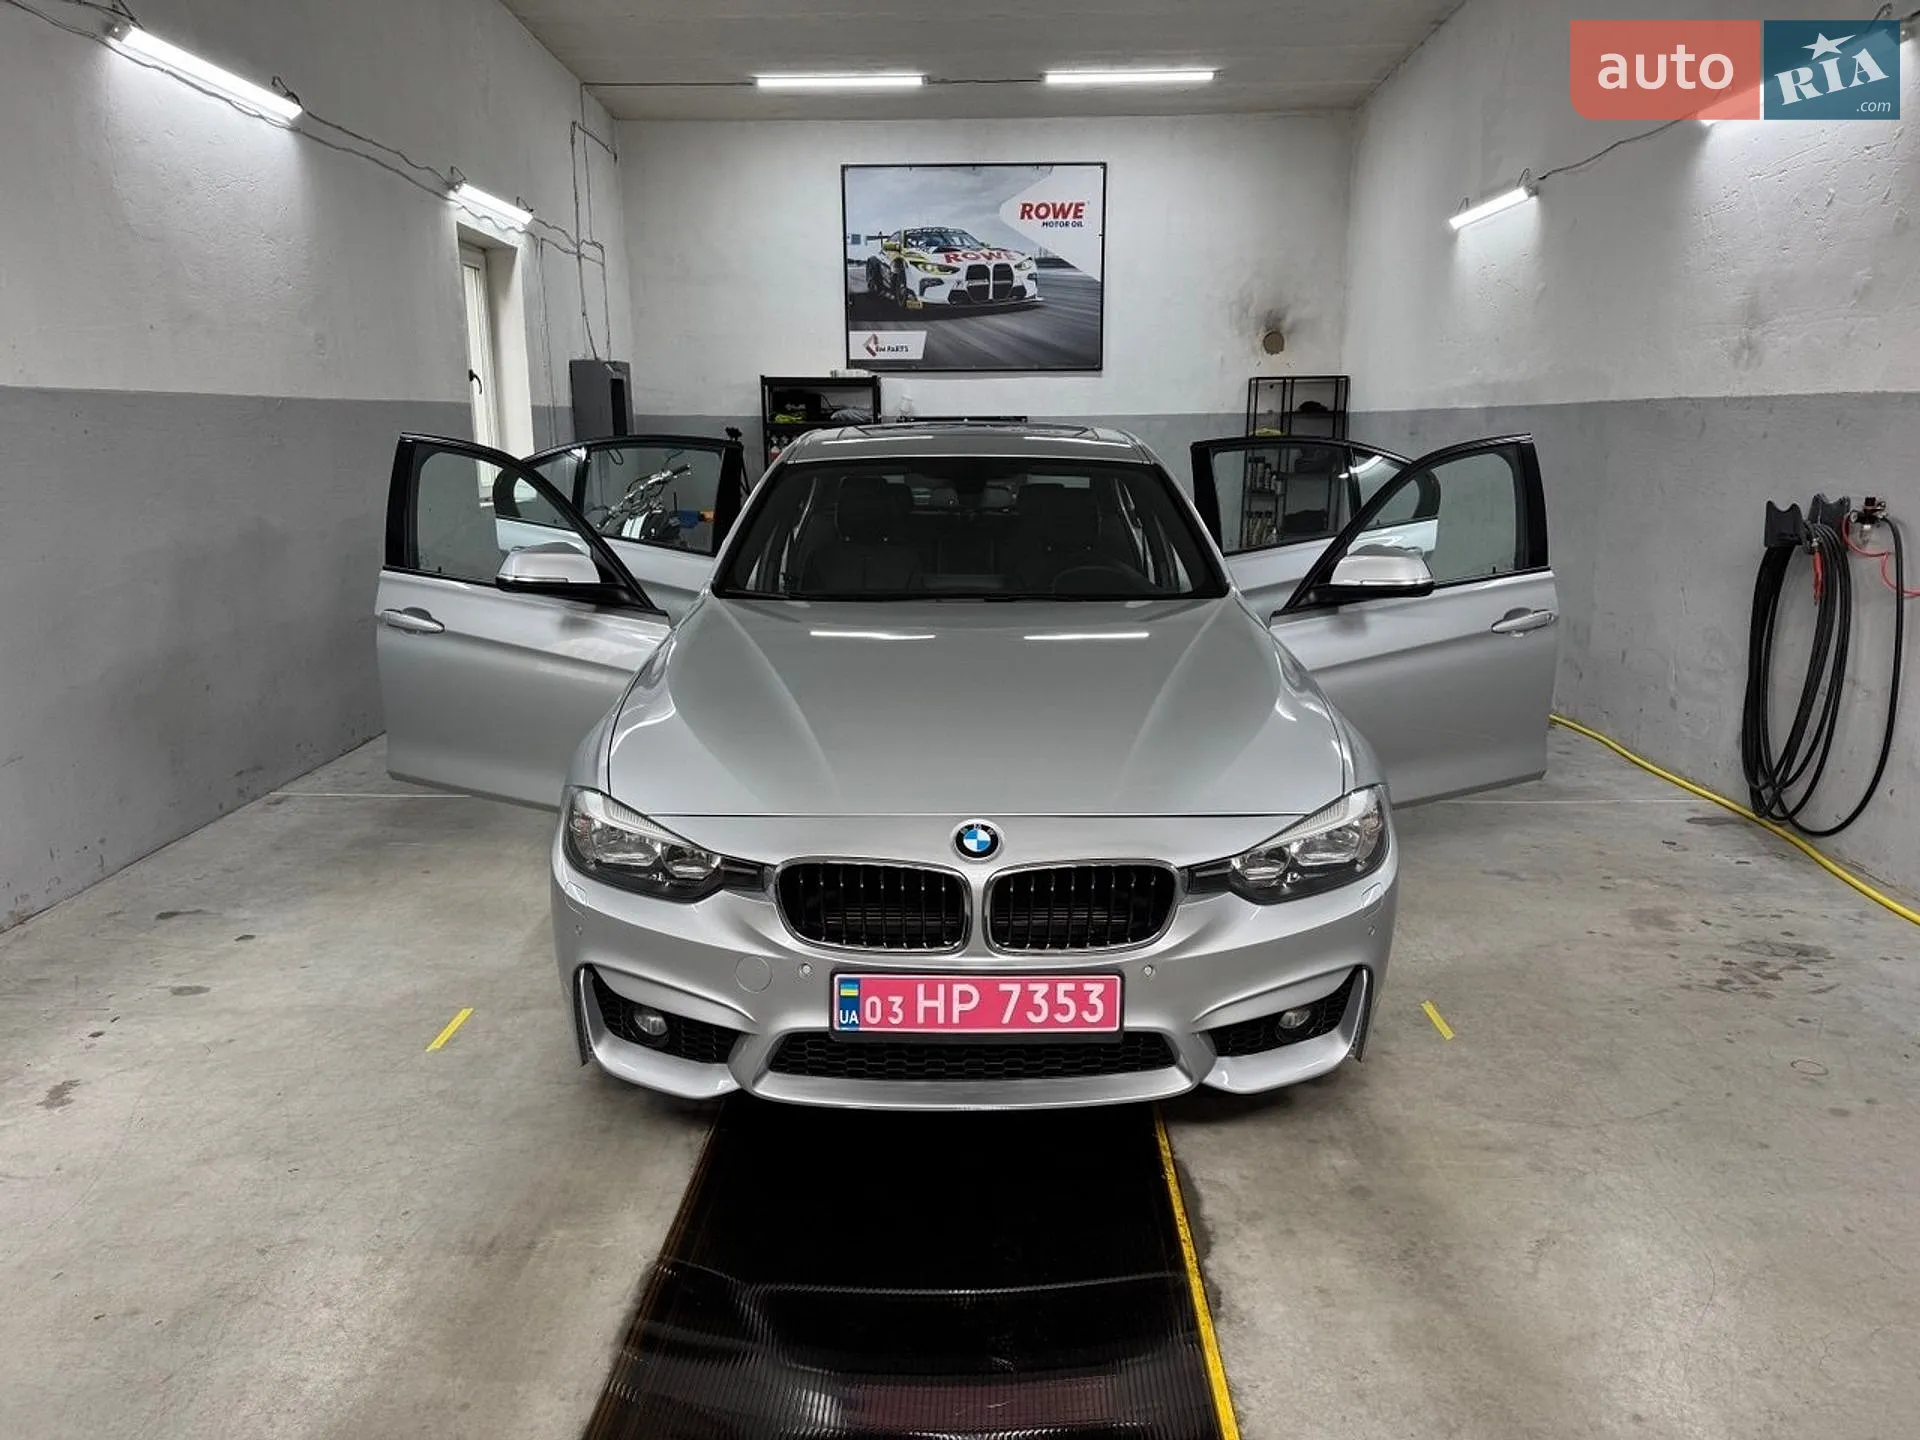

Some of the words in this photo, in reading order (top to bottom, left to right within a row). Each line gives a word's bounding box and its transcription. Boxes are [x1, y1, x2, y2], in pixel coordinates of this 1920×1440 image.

[1020, 202, 1085, 220] ROWE
[1042, 220, 1070, 228] MOTOR
[1071, 220, 1083, 228] OIL
[865, 995, 905, 1025] 03
[916, 983, 981, 1025] HP
[998, 983, 1105, 1024] 7353
[839, 1009, 860, 1025] UA
